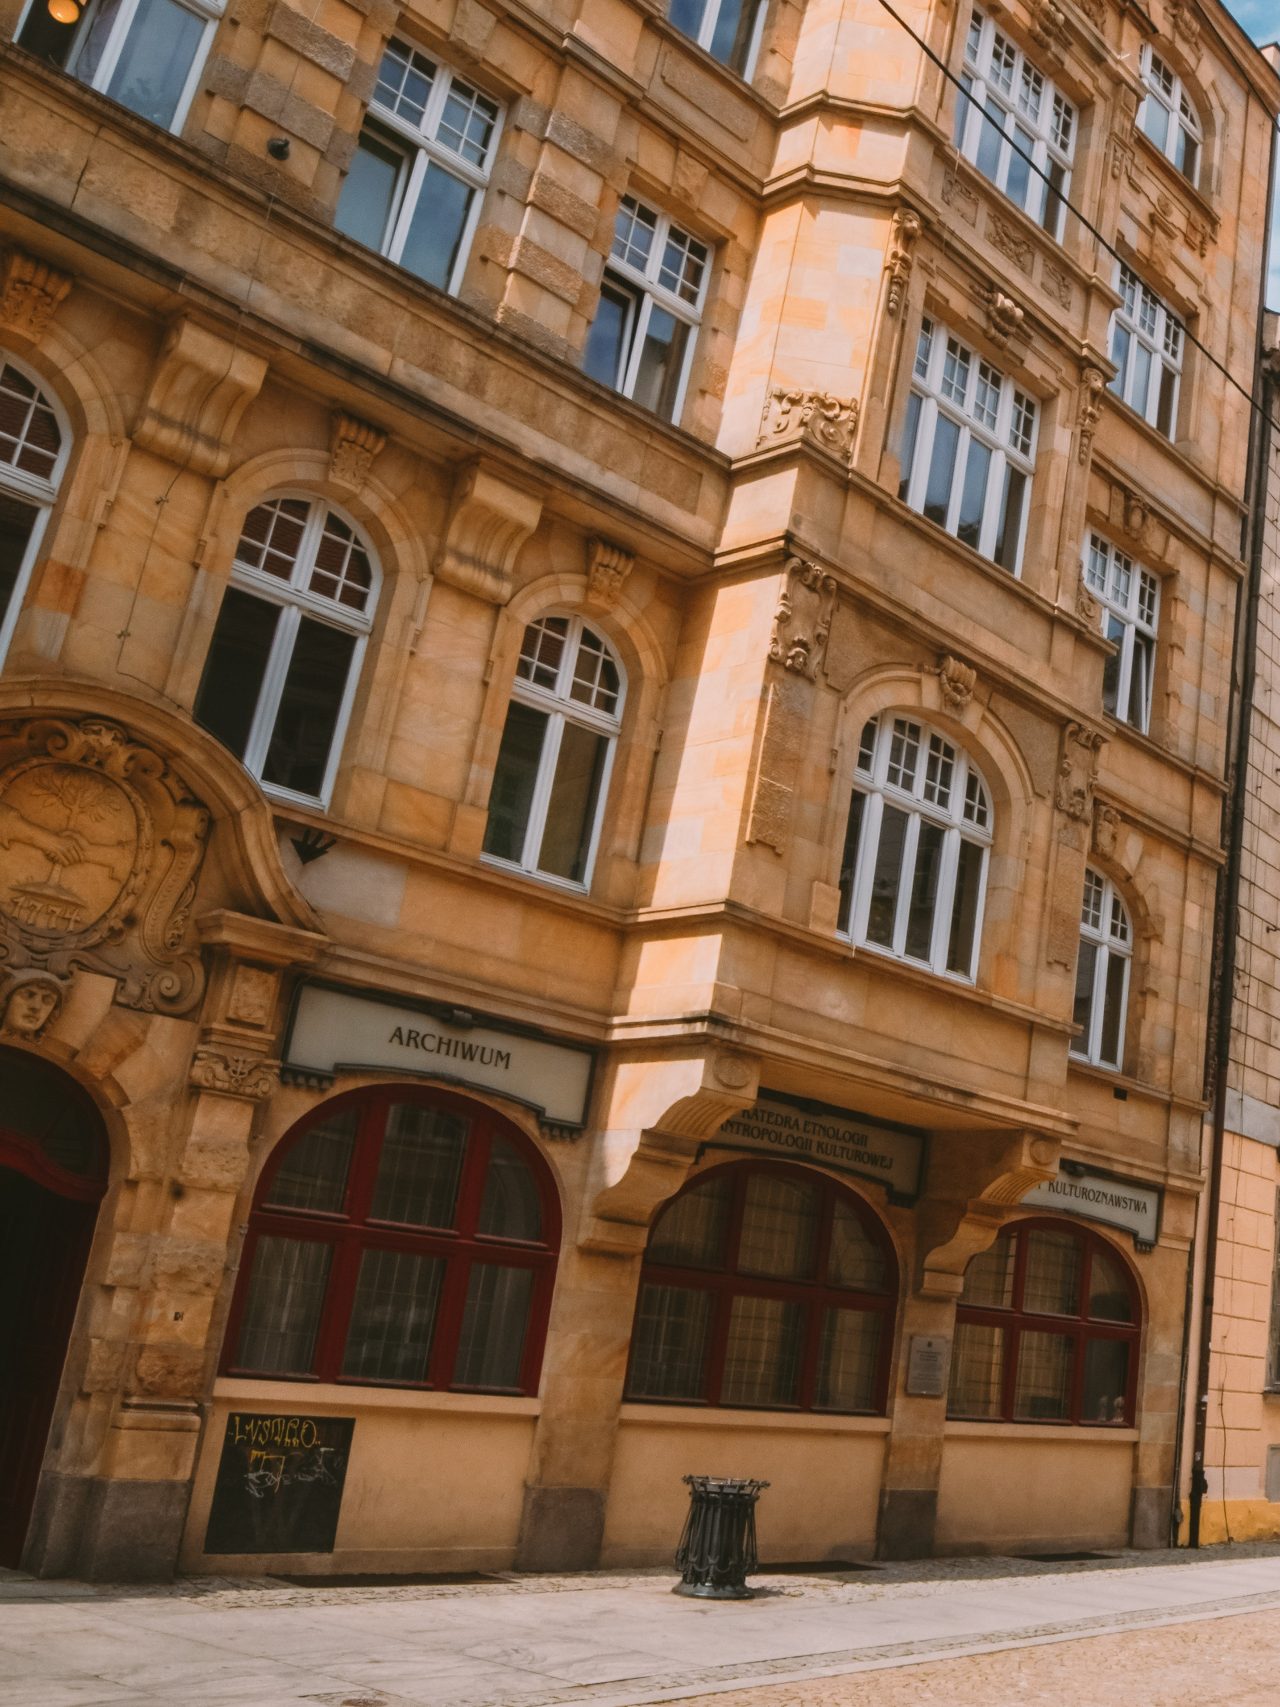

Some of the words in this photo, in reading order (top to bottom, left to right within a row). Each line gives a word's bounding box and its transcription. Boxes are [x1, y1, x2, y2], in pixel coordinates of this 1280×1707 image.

[388, 1026, 512, 1070] ARCHIWUM
[803, 1120, 868, 1147] ETNOLOGII
[816, 1141, 893, 1170] KULTUROWEJ
[1047, 1180, 1147, 1214] KULTUROZNAWSTWA
